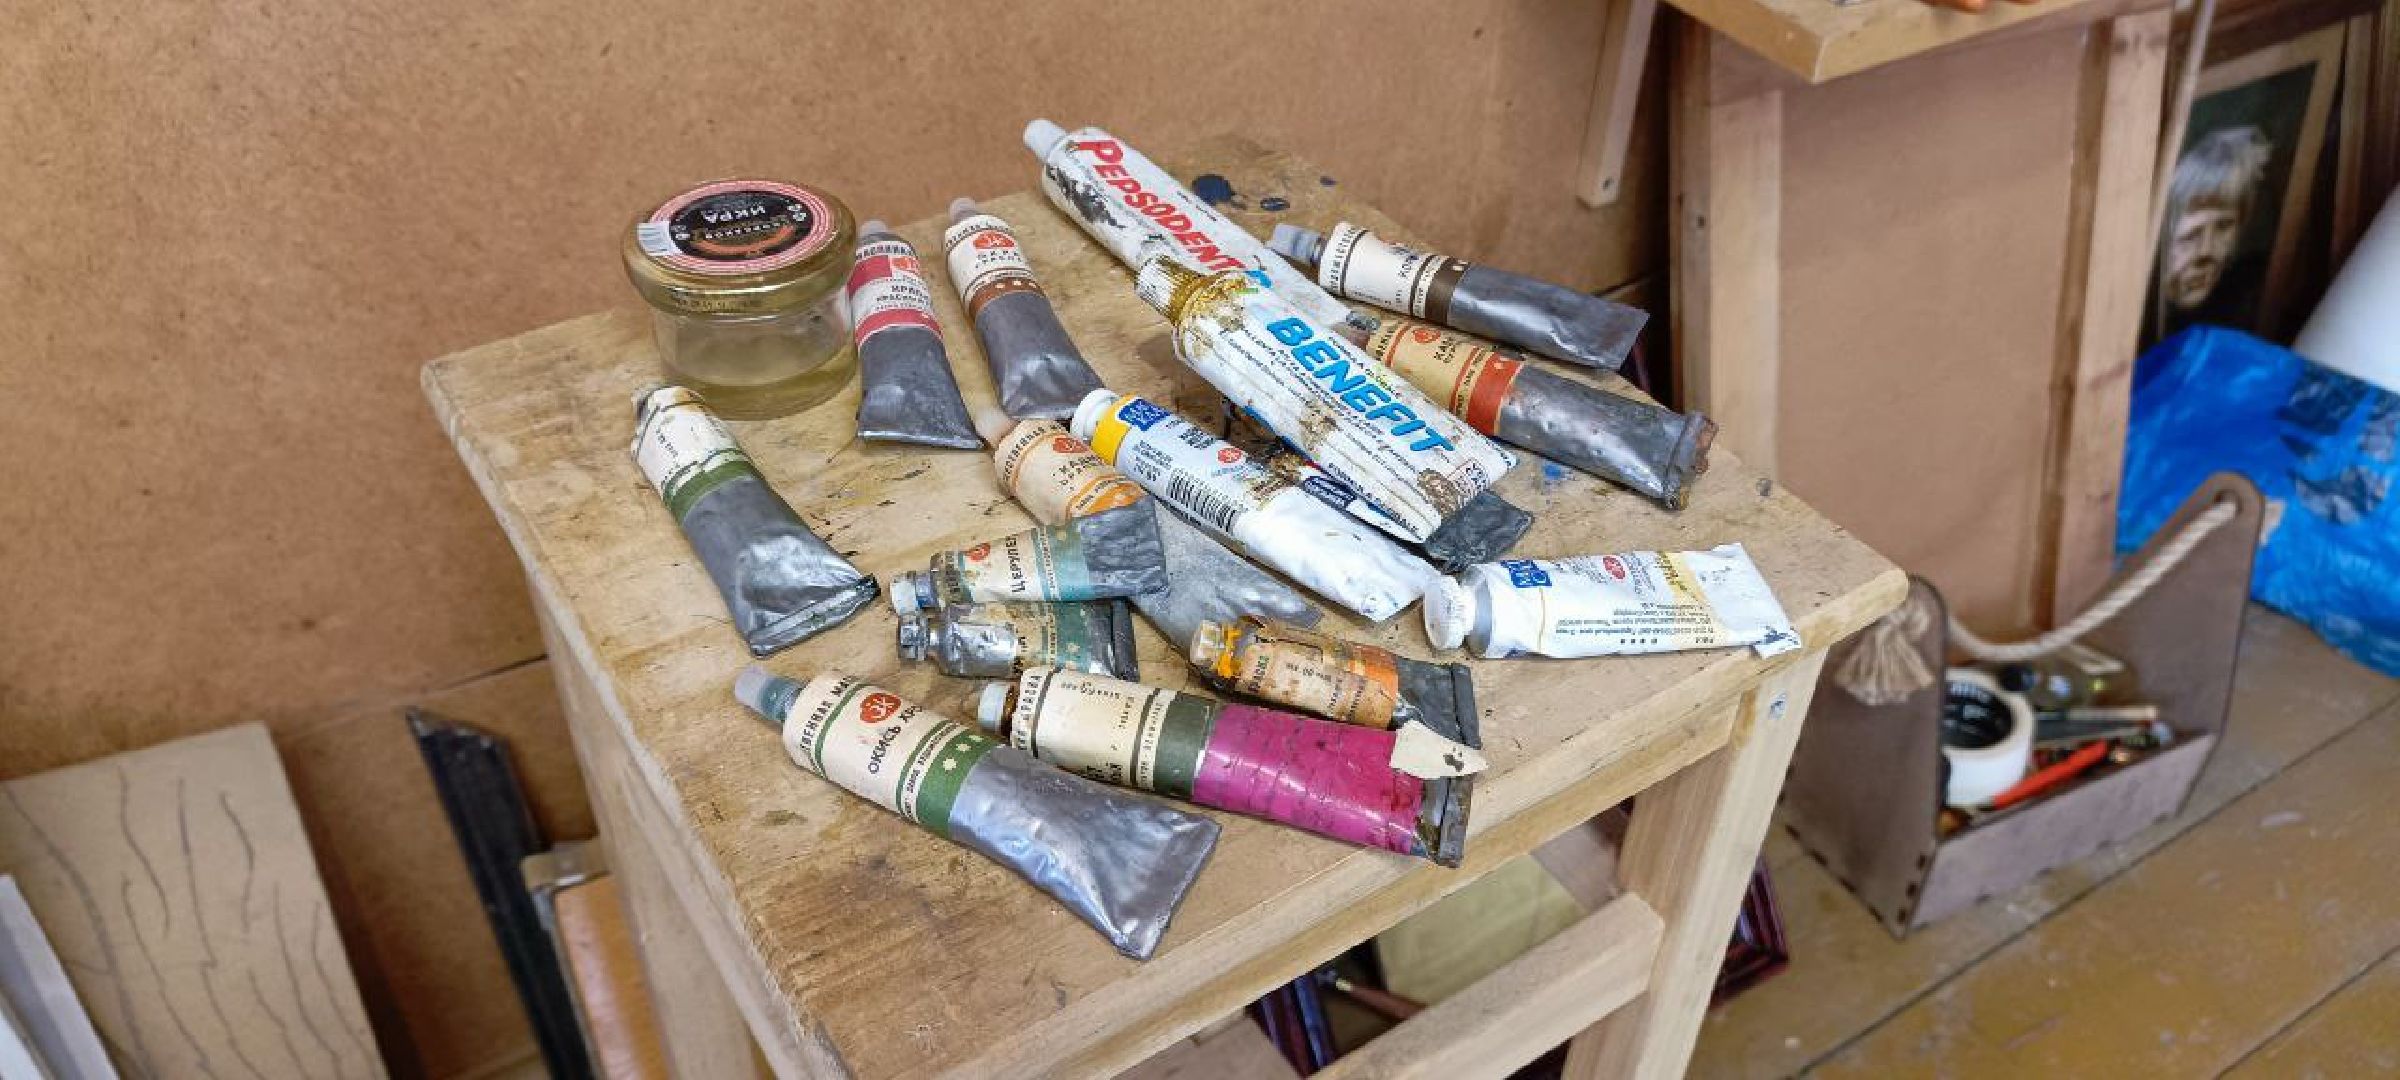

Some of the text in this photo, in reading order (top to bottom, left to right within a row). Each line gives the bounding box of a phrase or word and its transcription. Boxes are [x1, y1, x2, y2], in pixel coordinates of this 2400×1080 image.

[1077, 140, 1242, 271] PEPSODENT
[1265, 316, 1455, 453] BENEFIT
[867, 724, 902, 775] ОКИСЬ
